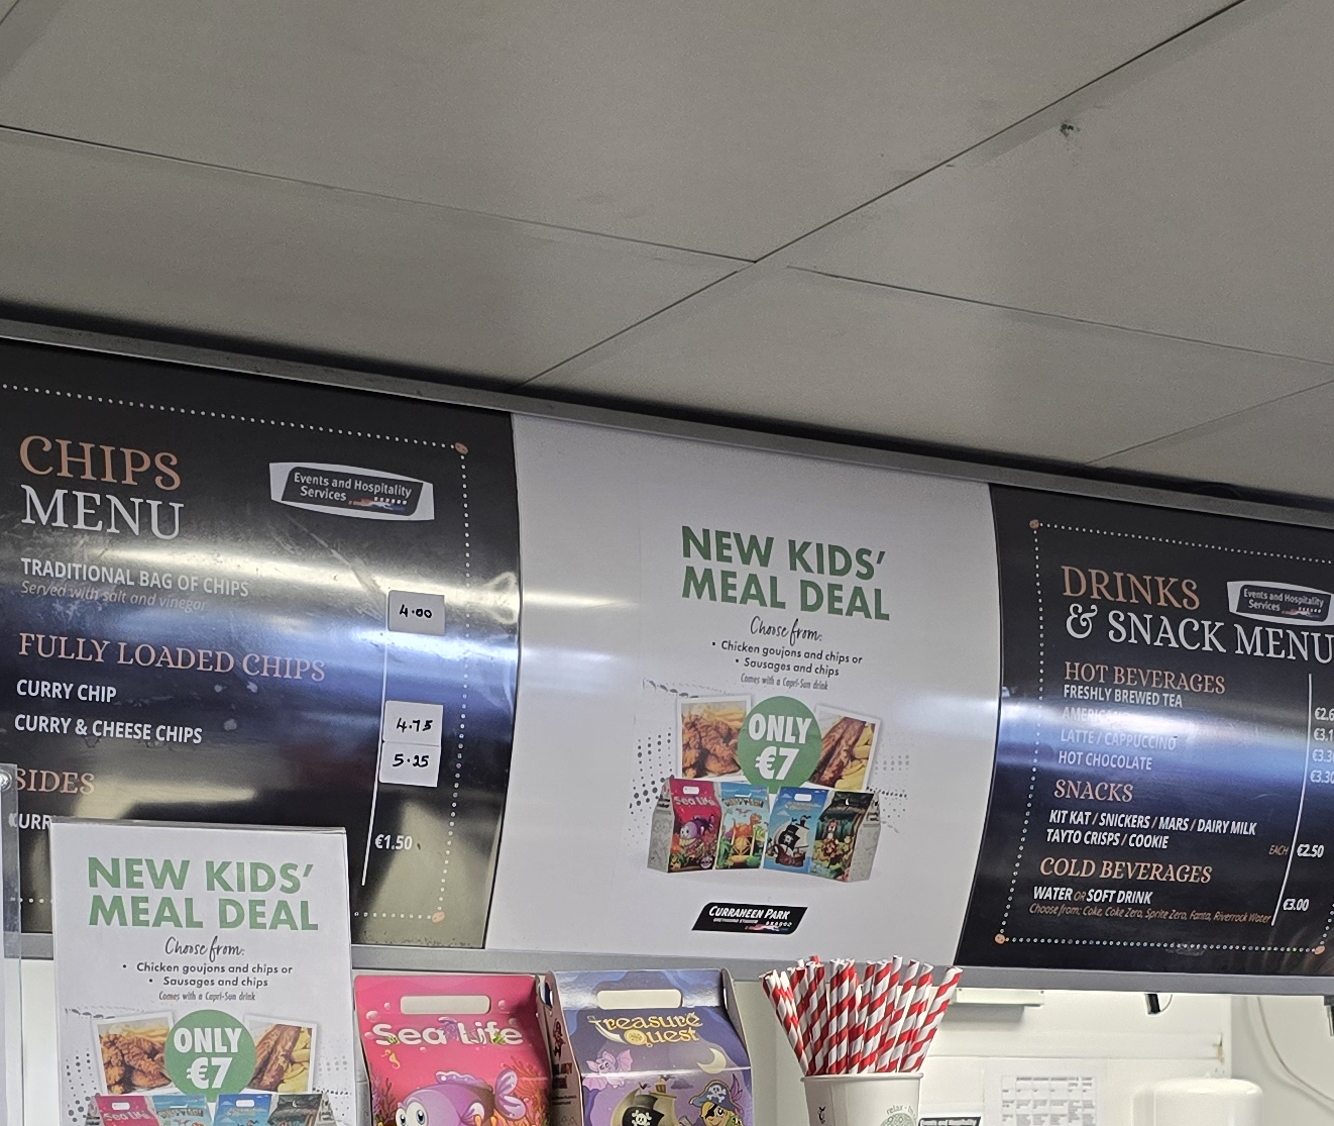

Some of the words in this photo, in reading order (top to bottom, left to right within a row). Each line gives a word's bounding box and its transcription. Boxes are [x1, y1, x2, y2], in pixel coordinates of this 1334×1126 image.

[20, 435, 181, 491] CHIPS
[21, 484, 184, 539] MENU
[681, 525, 774, 568] NEW
[682, 565, 786, 610] MEAL
[800, 579, 890, 621] DEAL
[1061, 566, 1200, 611] DRINKS
[1066, 604, 1098, 639] &
[1108, 610, 1226, 654] SNACK
[1235, 624, 1334, 664] MENU
[18, 632, 110, 662] FULLY
[117, 642, 234, 673] LOADED
[242, 653, 325, 682] CHIPS
[1065, 661, 1109, 683] HOT
[1113, 666, 1226, 695] BEVERAGES
[14, 714, 71, 735] CURRY
[75, 718, 88, 736] &
[92, 720, 151, 740] CHEESE
[156, 725, 203, 744] CHIPS
[748, 713, 812, 744] ONLY
[755, 746, 800, 780] €7
[16, 767, 95, 795] SIDES
[1054, 779, 1133, 802] SNACKS
[375, 834, 412, 850] €1.50
[1296, 844, 1324, 857] €2.50
[88, 857, 190, 890] NEW
[1040, 857, 1096, 877] COLD
[1099, 859, 1213, 884] BEVERAGES
[89, 895, 203, 929] MEAL
[219, 899, 319, 931] DEAL
[1282, 898, 1309, 911] €3.00
[165, 937, 206, 957] Choose
[207, 936, 245, 962] from:
[372, 1023, 448, 1046] Sea
[458, 1022, 524, 1046] Life
[588, 1012, 703, 1034] Treasure
[624, 1028, 700, 1048] Quest
[174, 1027, 242, 1053] ONLY
[186, 1057, 233, 1090] €7
